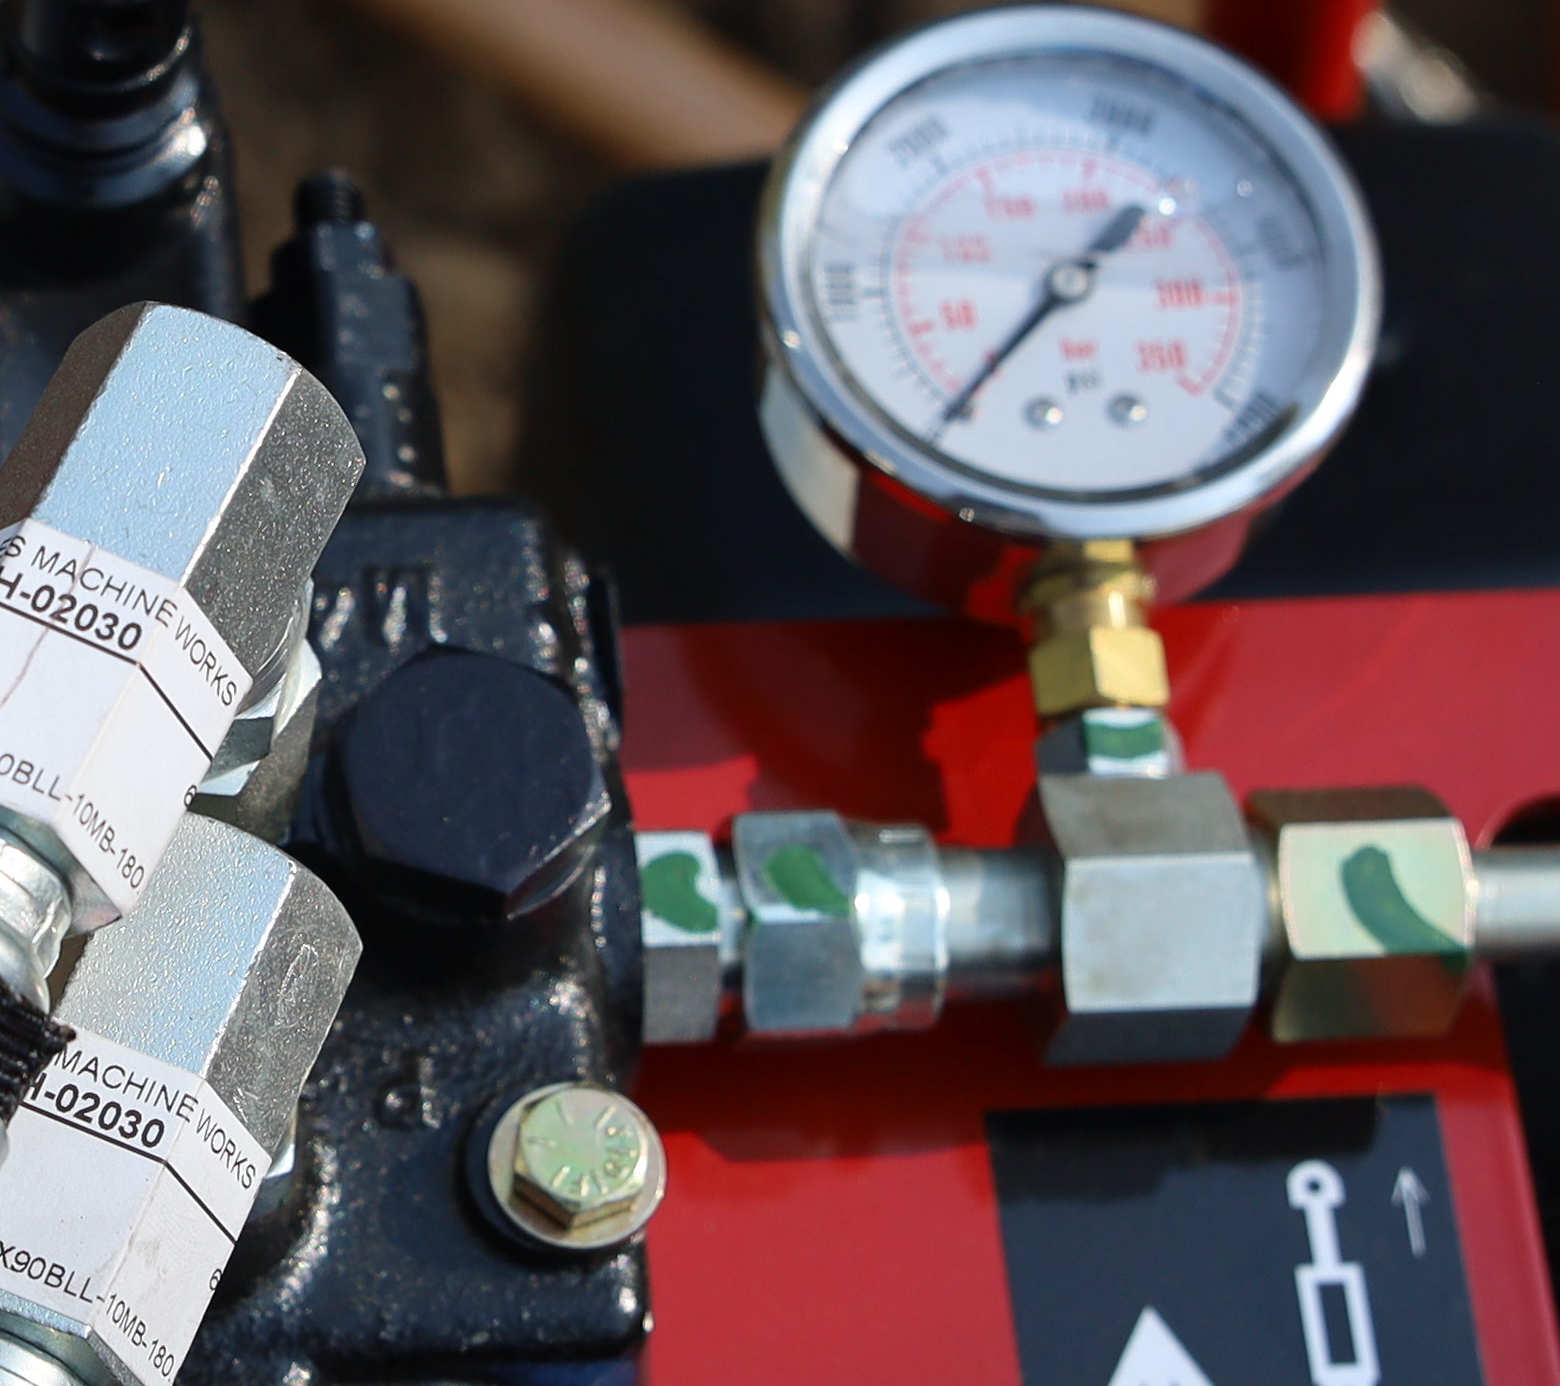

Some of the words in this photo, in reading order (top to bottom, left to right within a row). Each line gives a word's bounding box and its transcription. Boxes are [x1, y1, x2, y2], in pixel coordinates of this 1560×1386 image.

[34, 546, 177, 629] MACHINE
[175, 619, 239, 707] WORKS
[51, 1048, 199, 1123] MACHINE
[197, 1113, 257, 1191] WORKS
